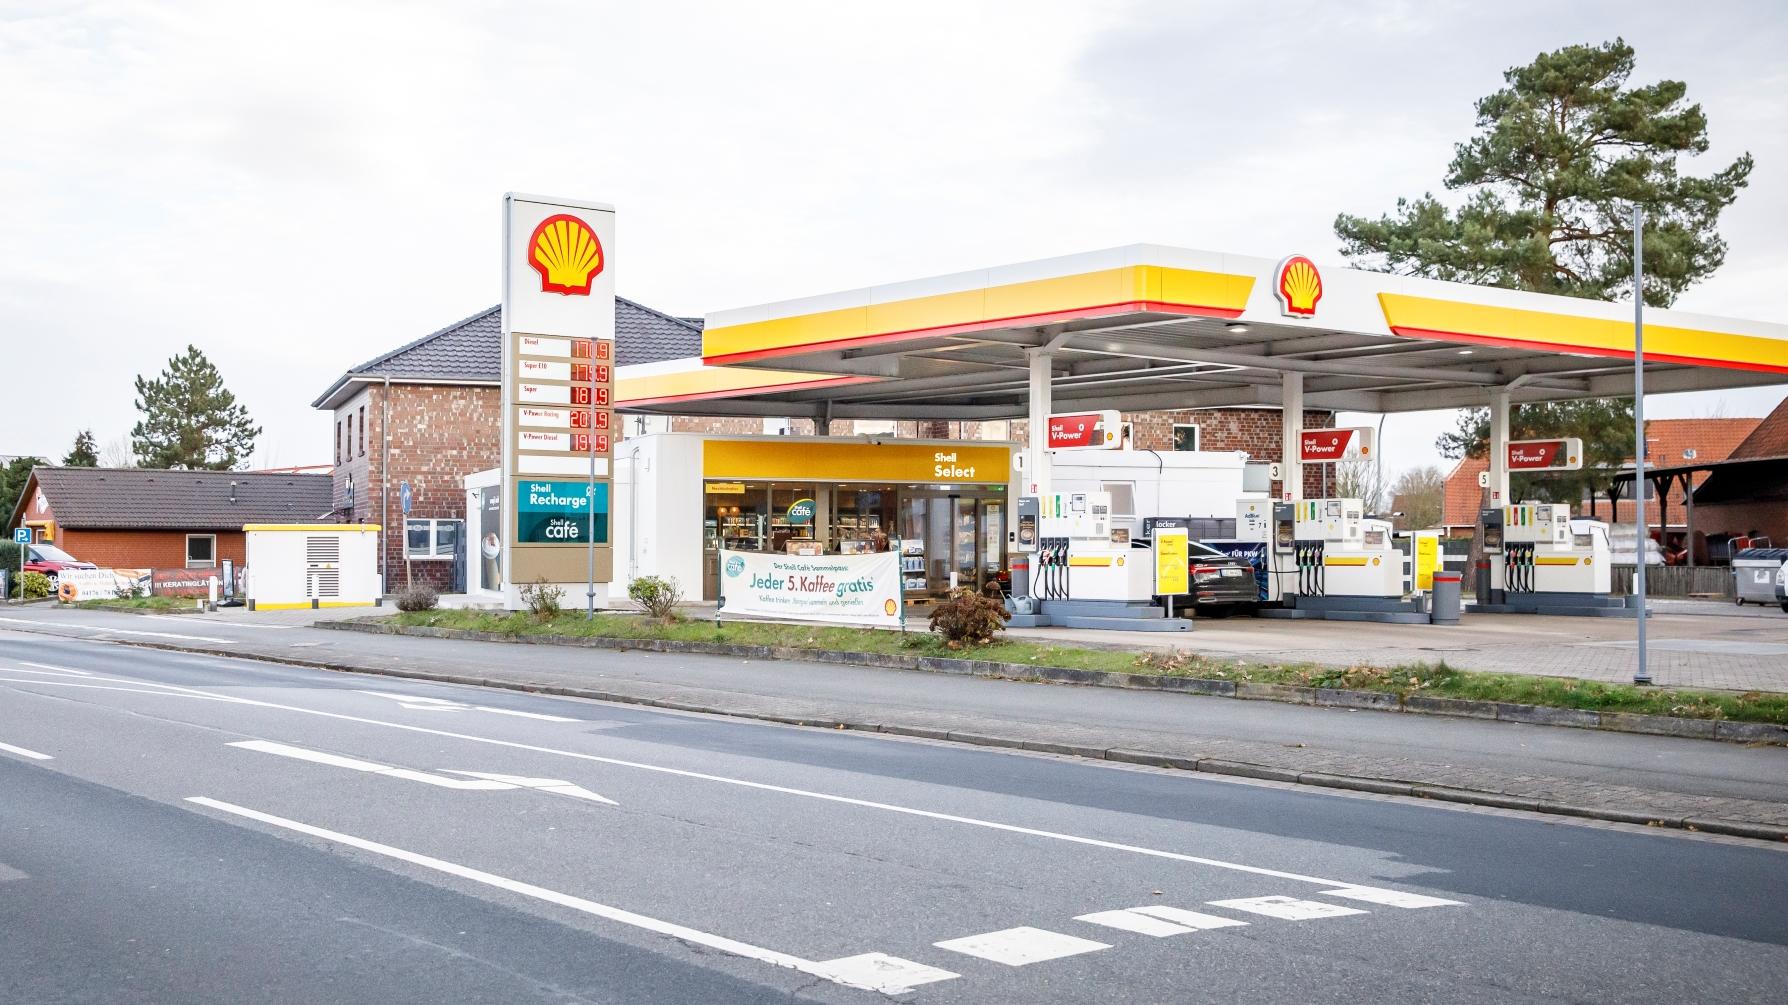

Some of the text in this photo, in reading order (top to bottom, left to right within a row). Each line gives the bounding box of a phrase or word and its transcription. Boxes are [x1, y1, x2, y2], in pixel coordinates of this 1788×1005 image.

[524, 362, 538, 370] Super
[1051, 432, 1082, 440] V-Power
[1304, 445, 1336, 453] V-Power
[934, 452, 957, 462] Shell
[934, 464, 976, 477] Select
[1272, 466, 1279, 477] 3
[1482, 475, 1487, 484] 5
[530, 484, 551, 493] Shell
[530, 493, 587, 509] Recharge
[545, 521, 579, 538] café
[17, 530, 27, 541] P
[749, 572, 784, 590] Jeder
[787, 575, 798, 591] 5.
[800, 575, 835, 592] Kaffee
